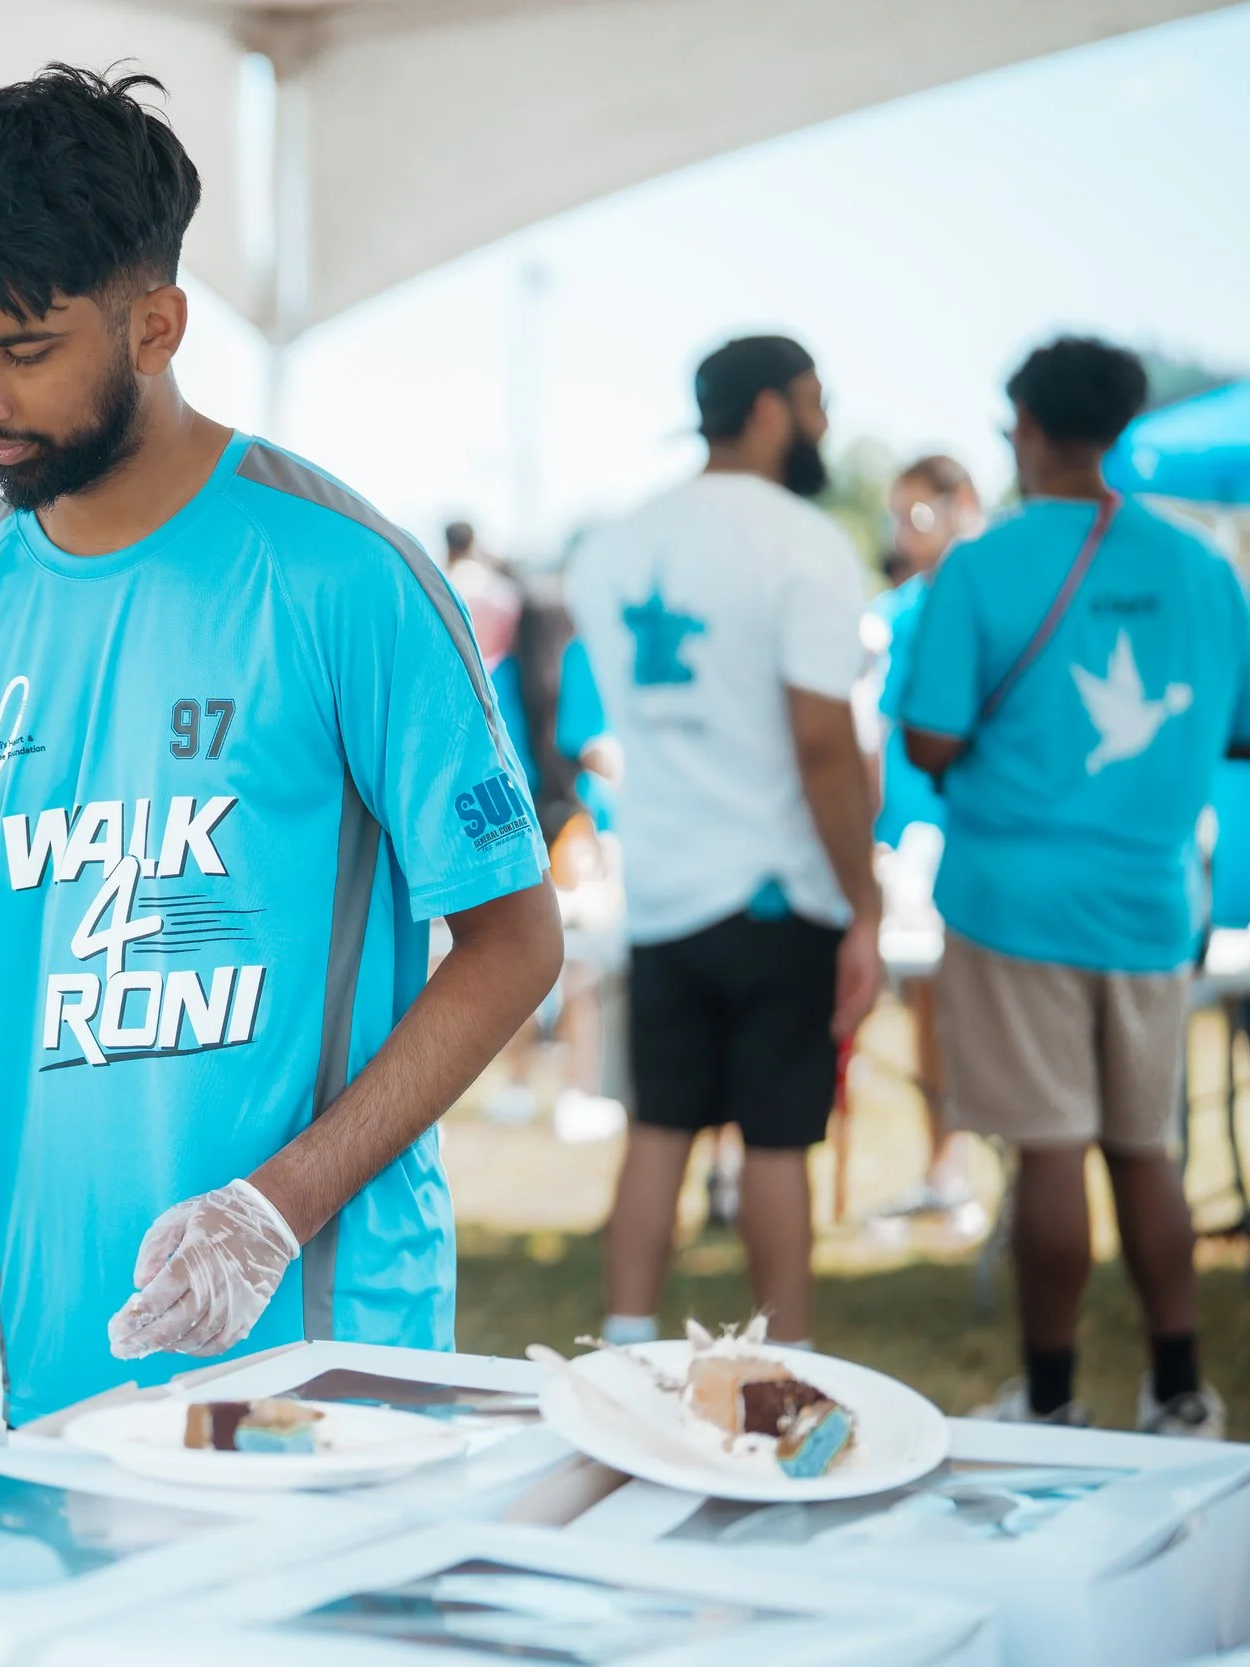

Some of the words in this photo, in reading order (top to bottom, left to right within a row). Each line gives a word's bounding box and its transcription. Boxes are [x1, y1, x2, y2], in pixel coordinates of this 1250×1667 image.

[27, 734, 34, 742] &
[169, 698, 236, 760] 97
[2, 796, 239, 891] WALK
[473, 829, 499, 849] GENERAL
[70, 855, 164, 982] 4
[42, 965, 267, 1068] RONI
